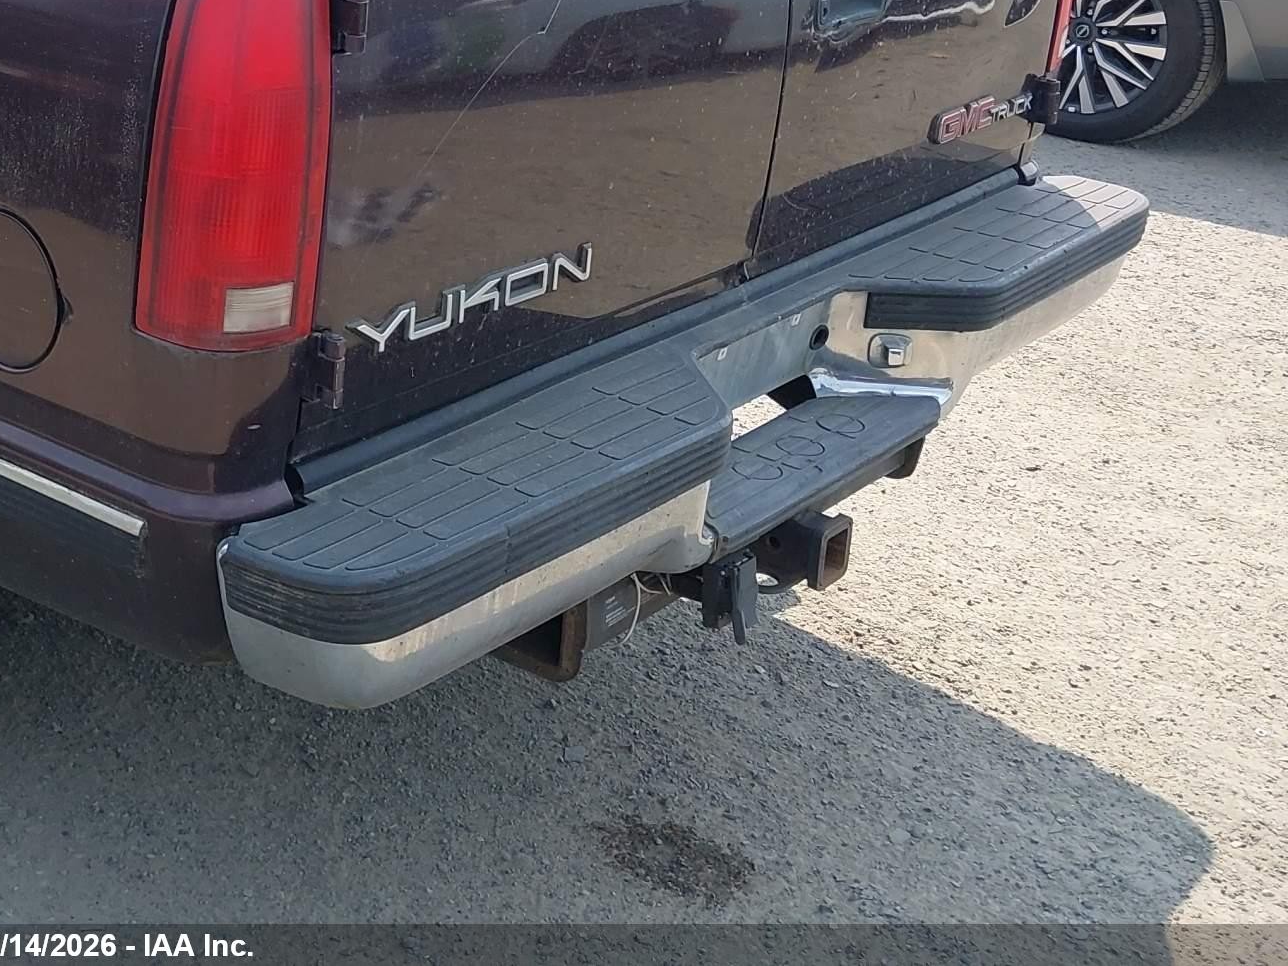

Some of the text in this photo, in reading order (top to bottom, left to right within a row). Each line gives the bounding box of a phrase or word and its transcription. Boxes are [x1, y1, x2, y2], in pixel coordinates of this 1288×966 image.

[938, 92, 1033, 144] GMC TRUCK
[355, 242, 593, 353] YUKON
